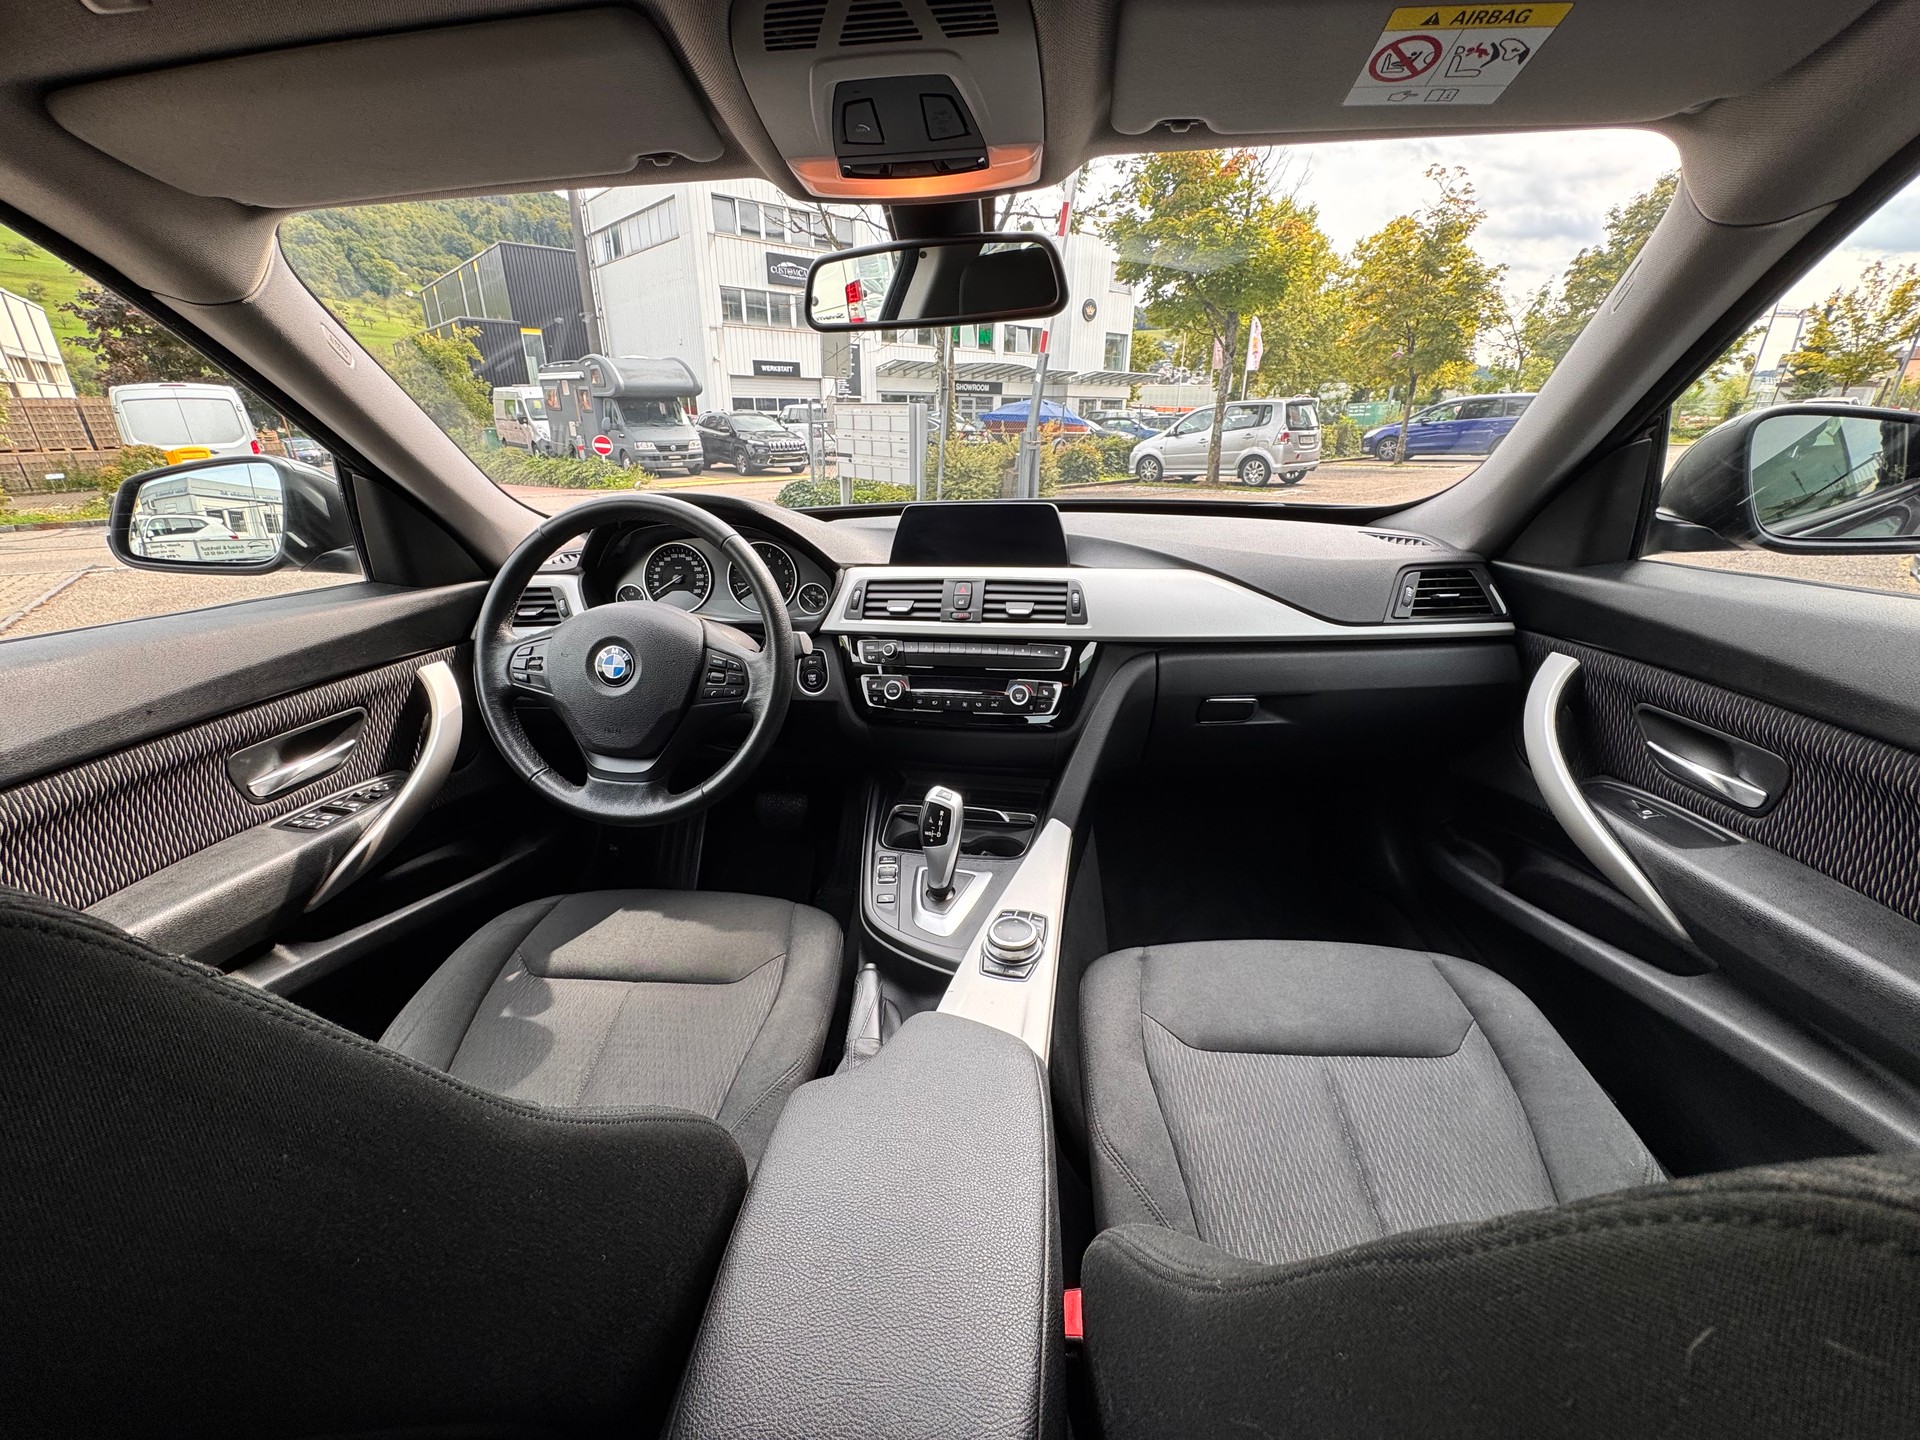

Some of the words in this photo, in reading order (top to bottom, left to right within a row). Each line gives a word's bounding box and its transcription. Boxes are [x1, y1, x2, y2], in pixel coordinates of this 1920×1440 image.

[1450, 8, 1533, 25] AIRBAG
[761, 365, 793, 373] WERKSTATT
[955, 383, 990, 391] SHOWROOM
[600, 648, 630, 661] BMW
